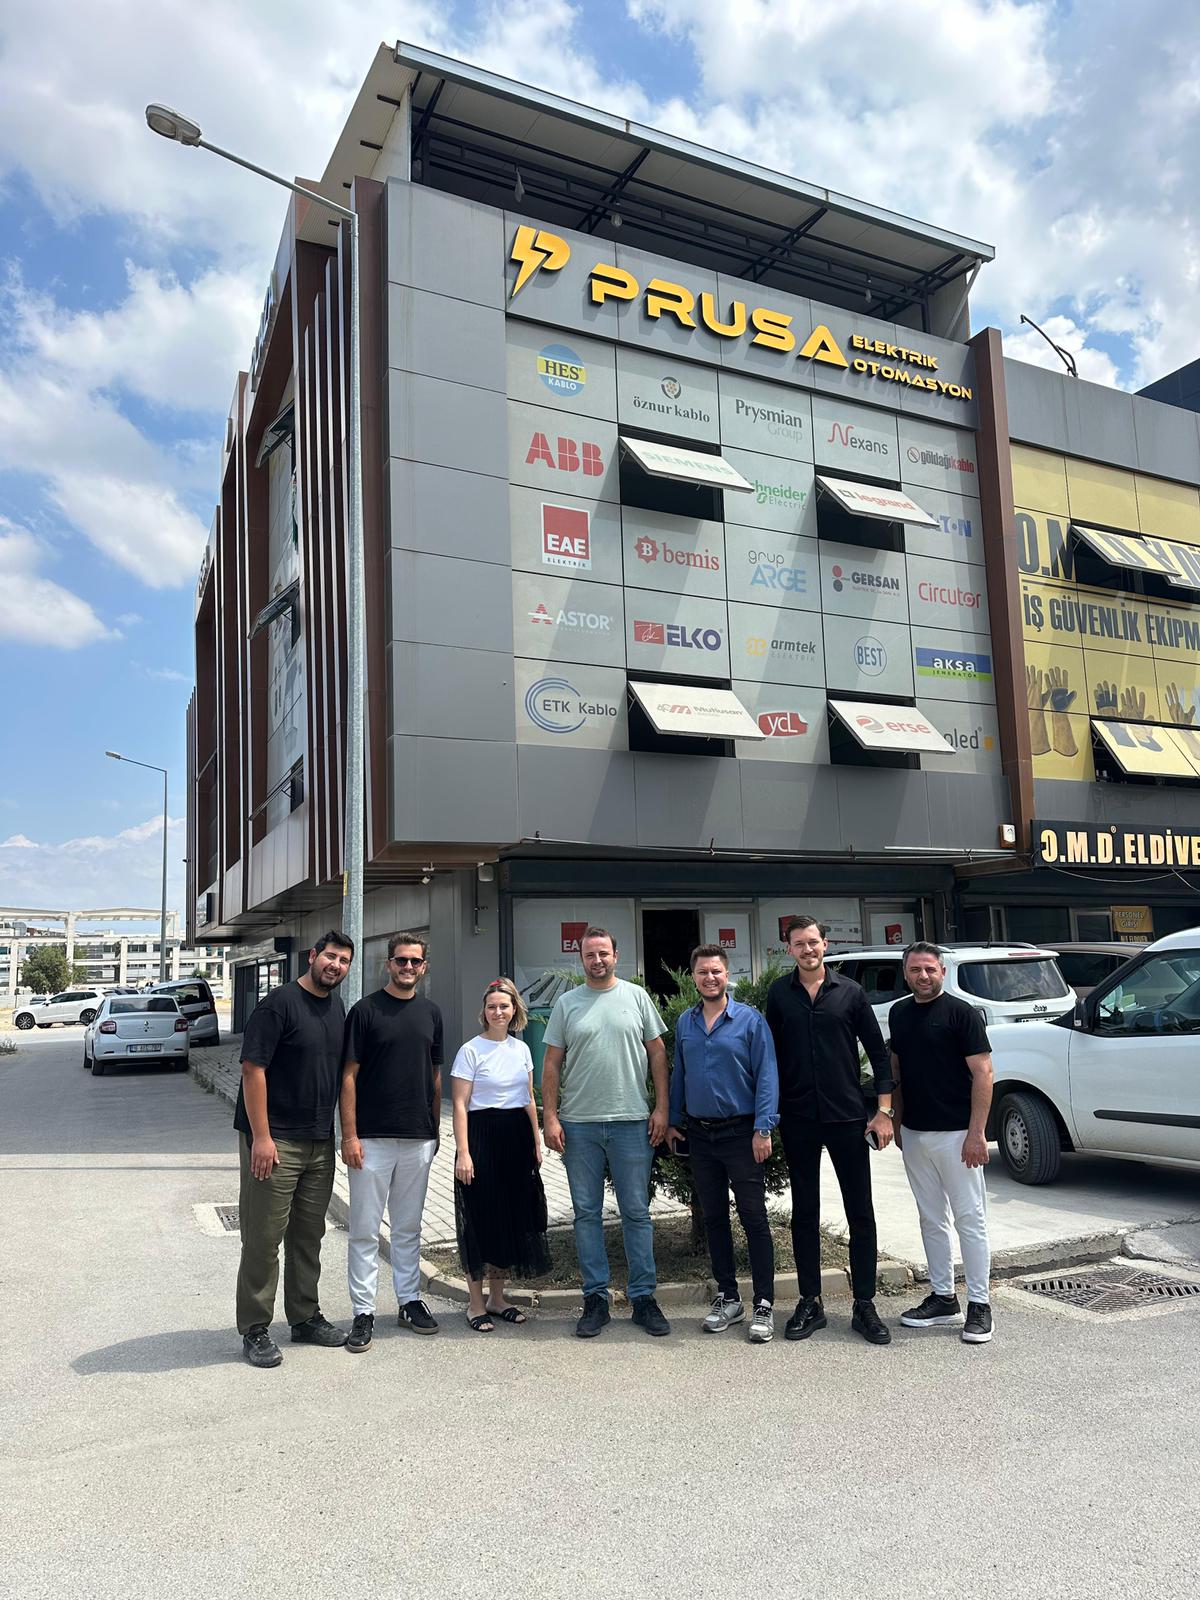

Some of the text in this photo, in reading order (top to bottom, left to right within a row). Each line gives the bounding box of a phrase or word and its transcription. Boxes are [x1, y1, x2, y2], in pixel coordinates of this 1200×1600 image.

[588, 263, 850, 369] PRUSA
[544, 359, 579, 380] HES
[853, 360, 973, 400] OTOMASYON
[548, 378, 577, 391] KABLO
[633, 396, 710, 423] öznur kablo
[735, 398, 803, 428] Prysmian
[767, 422, 803, 444] Group
[827, 422, 889, 455] Nexans
[525, 431, 605, 477] ABB
[640, 451, 734, 475] SIEMENS
[748, 479, 807, 502] hneider
[855, 491, 916, 511] legrand
[547, 533, 586, 557] EAE
[663, 542, 720, 571] bemis
[748, 549, 785, 568] grup
[750, 564, 807, 593] ARGE
[851, 571, 900, 591] GERSAN
[918, 582, 982, 609] Circutor
[556, 609, 610, 631] ASTOR
[1023, 586, 1045, 632] İŞ
[1049, 594, 1142, 643] GÜVENLİK
[667, 624, 722, 651] ELKO
[771, 639, 816, 654] armtek
[857, 645, 883, 668] BEST
[543, 699, 617, 717] ETK Kablo
[885, 719, 931, 734] erse
[563, 939, 580, 951] EA
[720, 939, 736, 948] EAE
